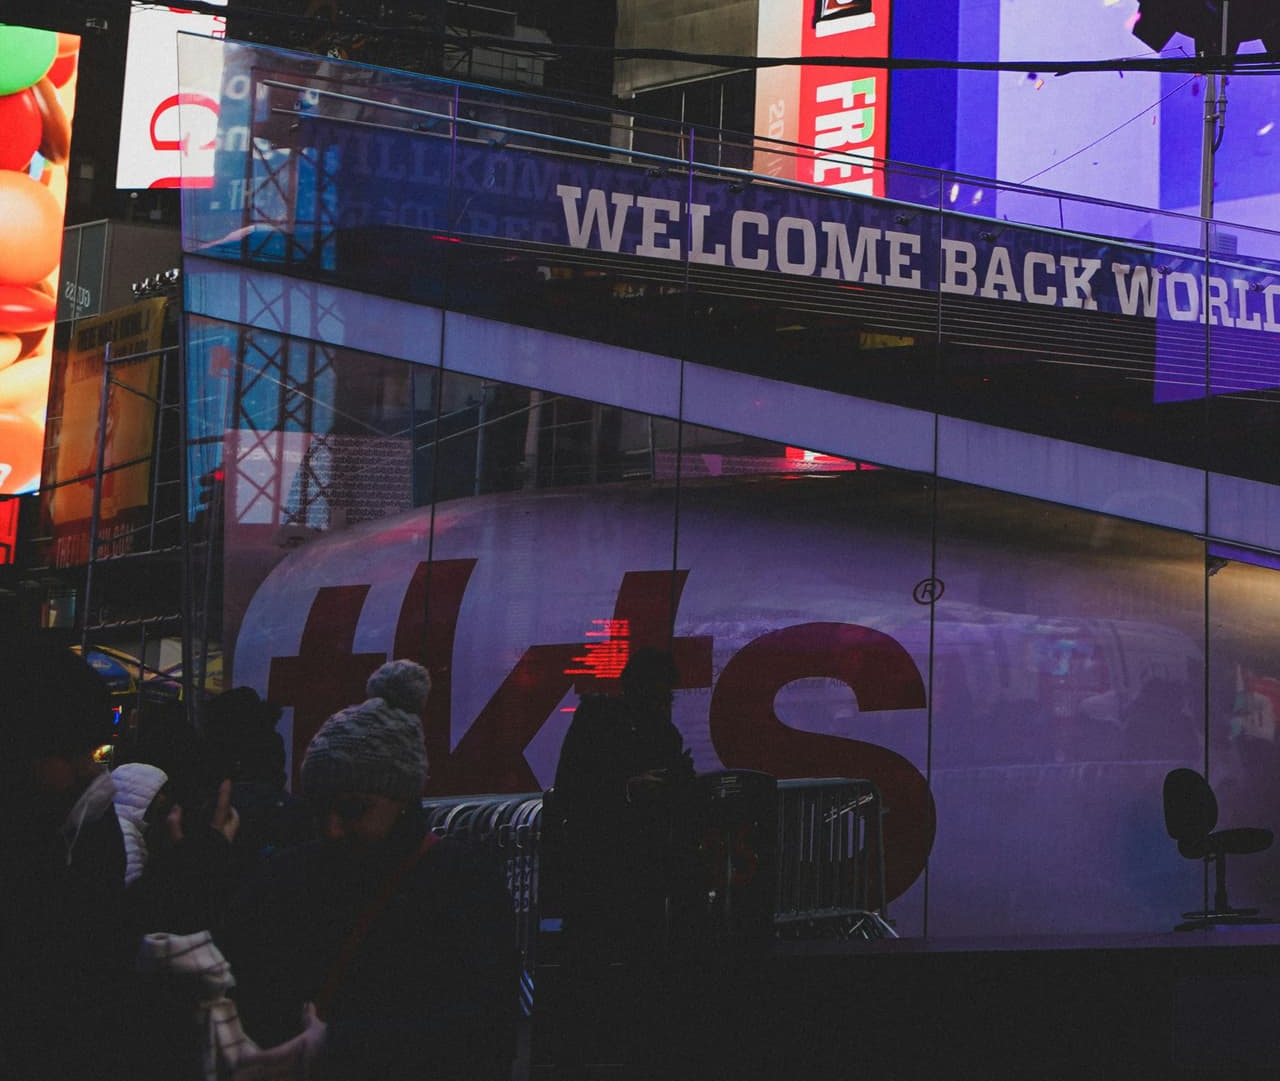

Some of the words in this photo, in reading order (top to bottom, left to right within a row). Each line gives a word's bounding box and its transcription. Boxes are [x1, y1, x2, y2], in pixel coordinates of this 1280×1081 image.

[557, 184, 922, 291] WELCOME
[942, 239, 1098, 311] BACK
[268, 559, 936, 910] tkts
